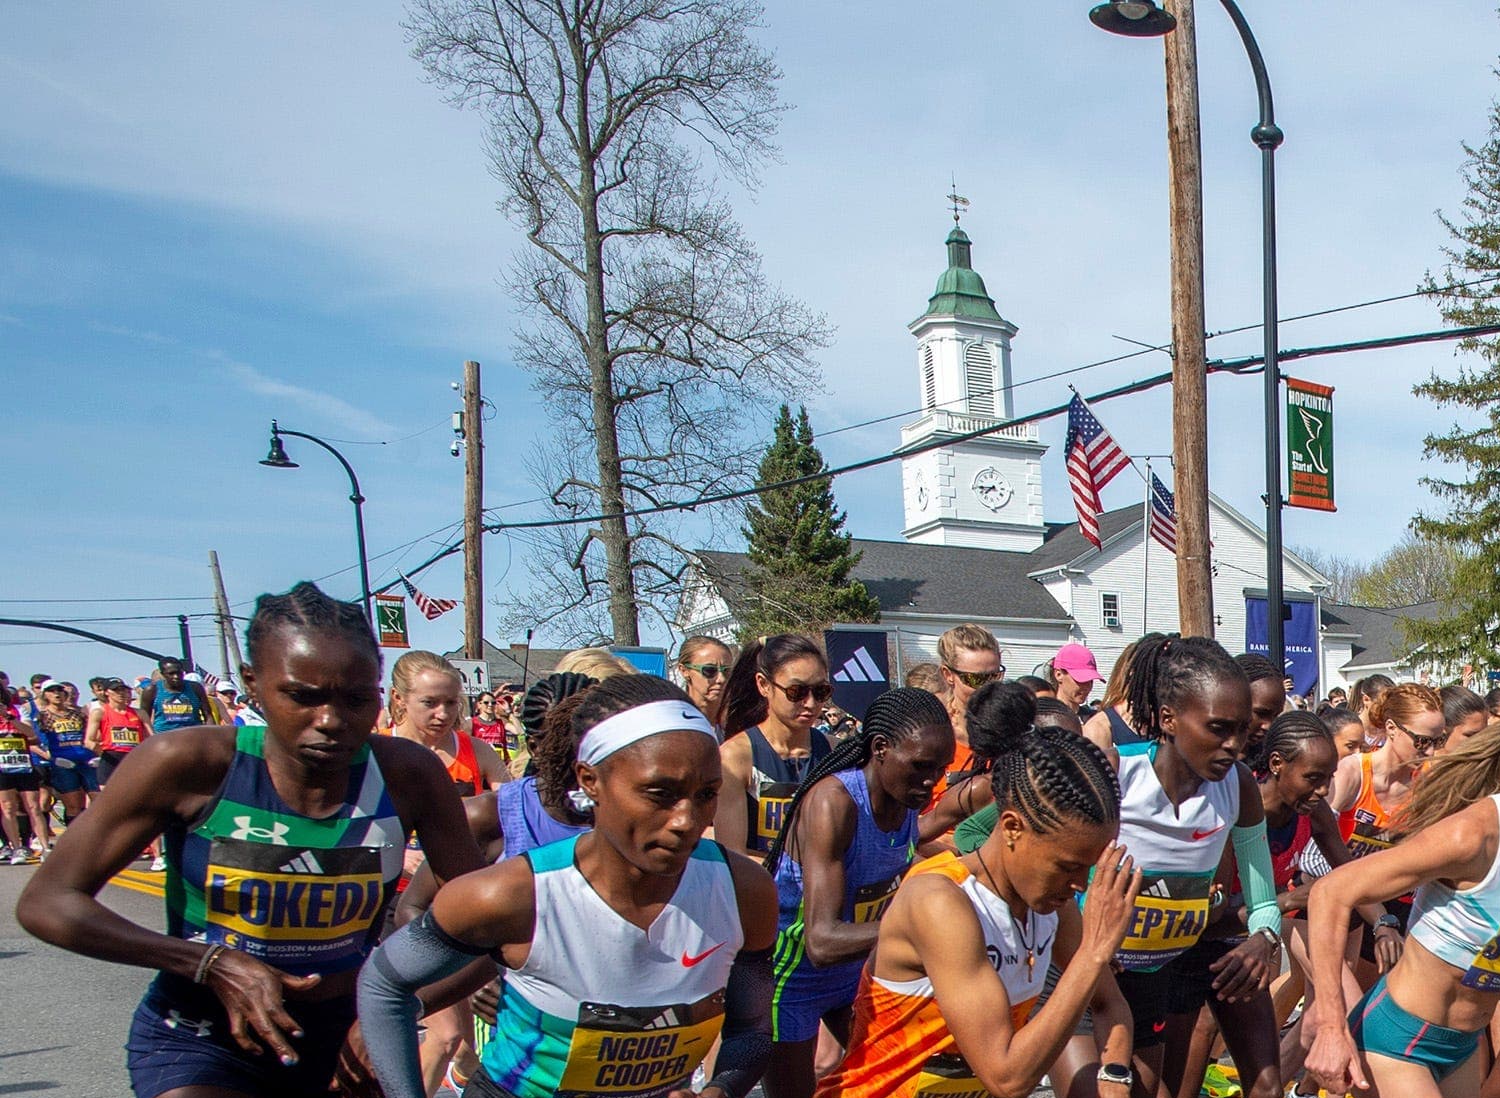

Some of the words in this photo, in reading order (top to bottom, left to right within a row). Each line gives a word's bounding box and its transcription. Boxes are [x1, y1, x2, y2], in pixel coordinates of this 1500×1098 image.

[1285, 645, 1313, 653] MERICA
[211, 873, 380, 929] LOKEDI
[1126, 905, 1206, 939] EPTAI
[597, 1032, 680, 1062] NGUGI
[594, 1053, 690, 1088] COOPER
